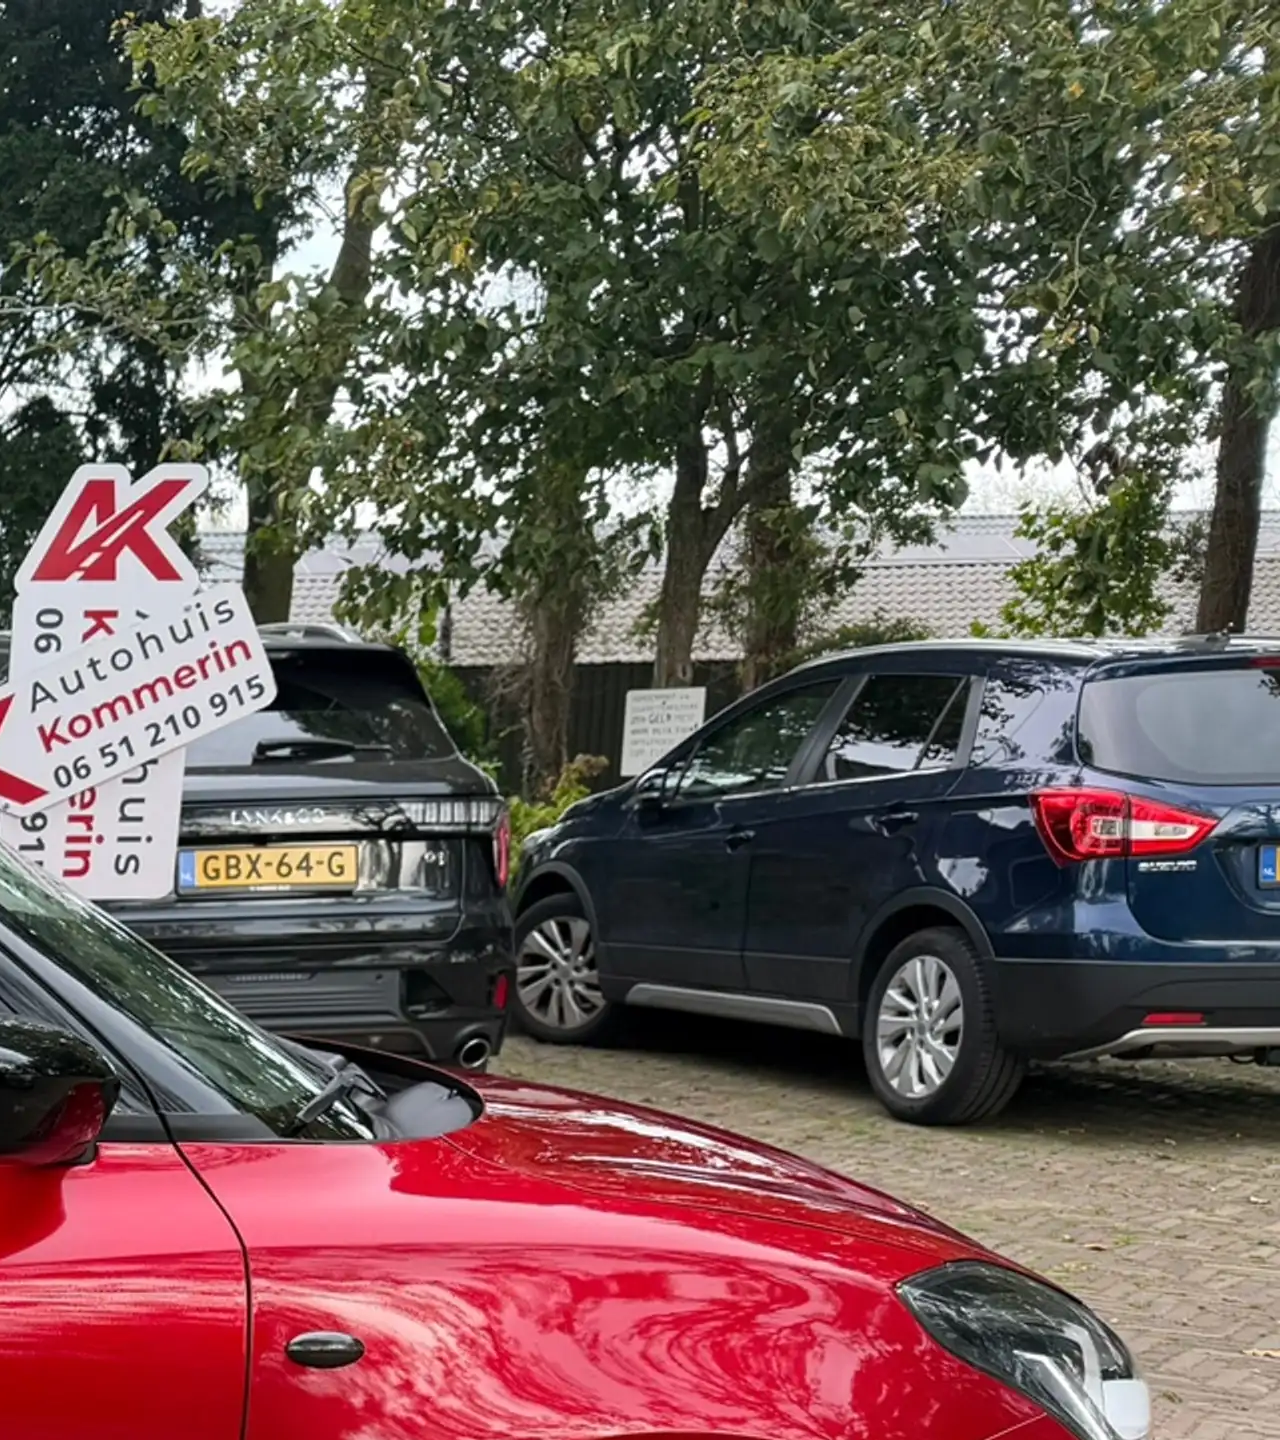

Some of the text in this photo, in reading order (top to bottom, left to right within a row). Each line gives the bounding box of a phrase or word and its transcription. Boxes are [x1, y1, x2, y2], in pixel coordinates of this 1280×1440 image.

[31, 479, 193, 581] AK
[31, 600, 235, 713] Autohuis
[34, 608, 64, 653] 06
[37, 639, 252, 754] Kommerin
[53, 675, 265, 788] 06 51 210 915
[202, 851, 346, 881] GBX-64-G
